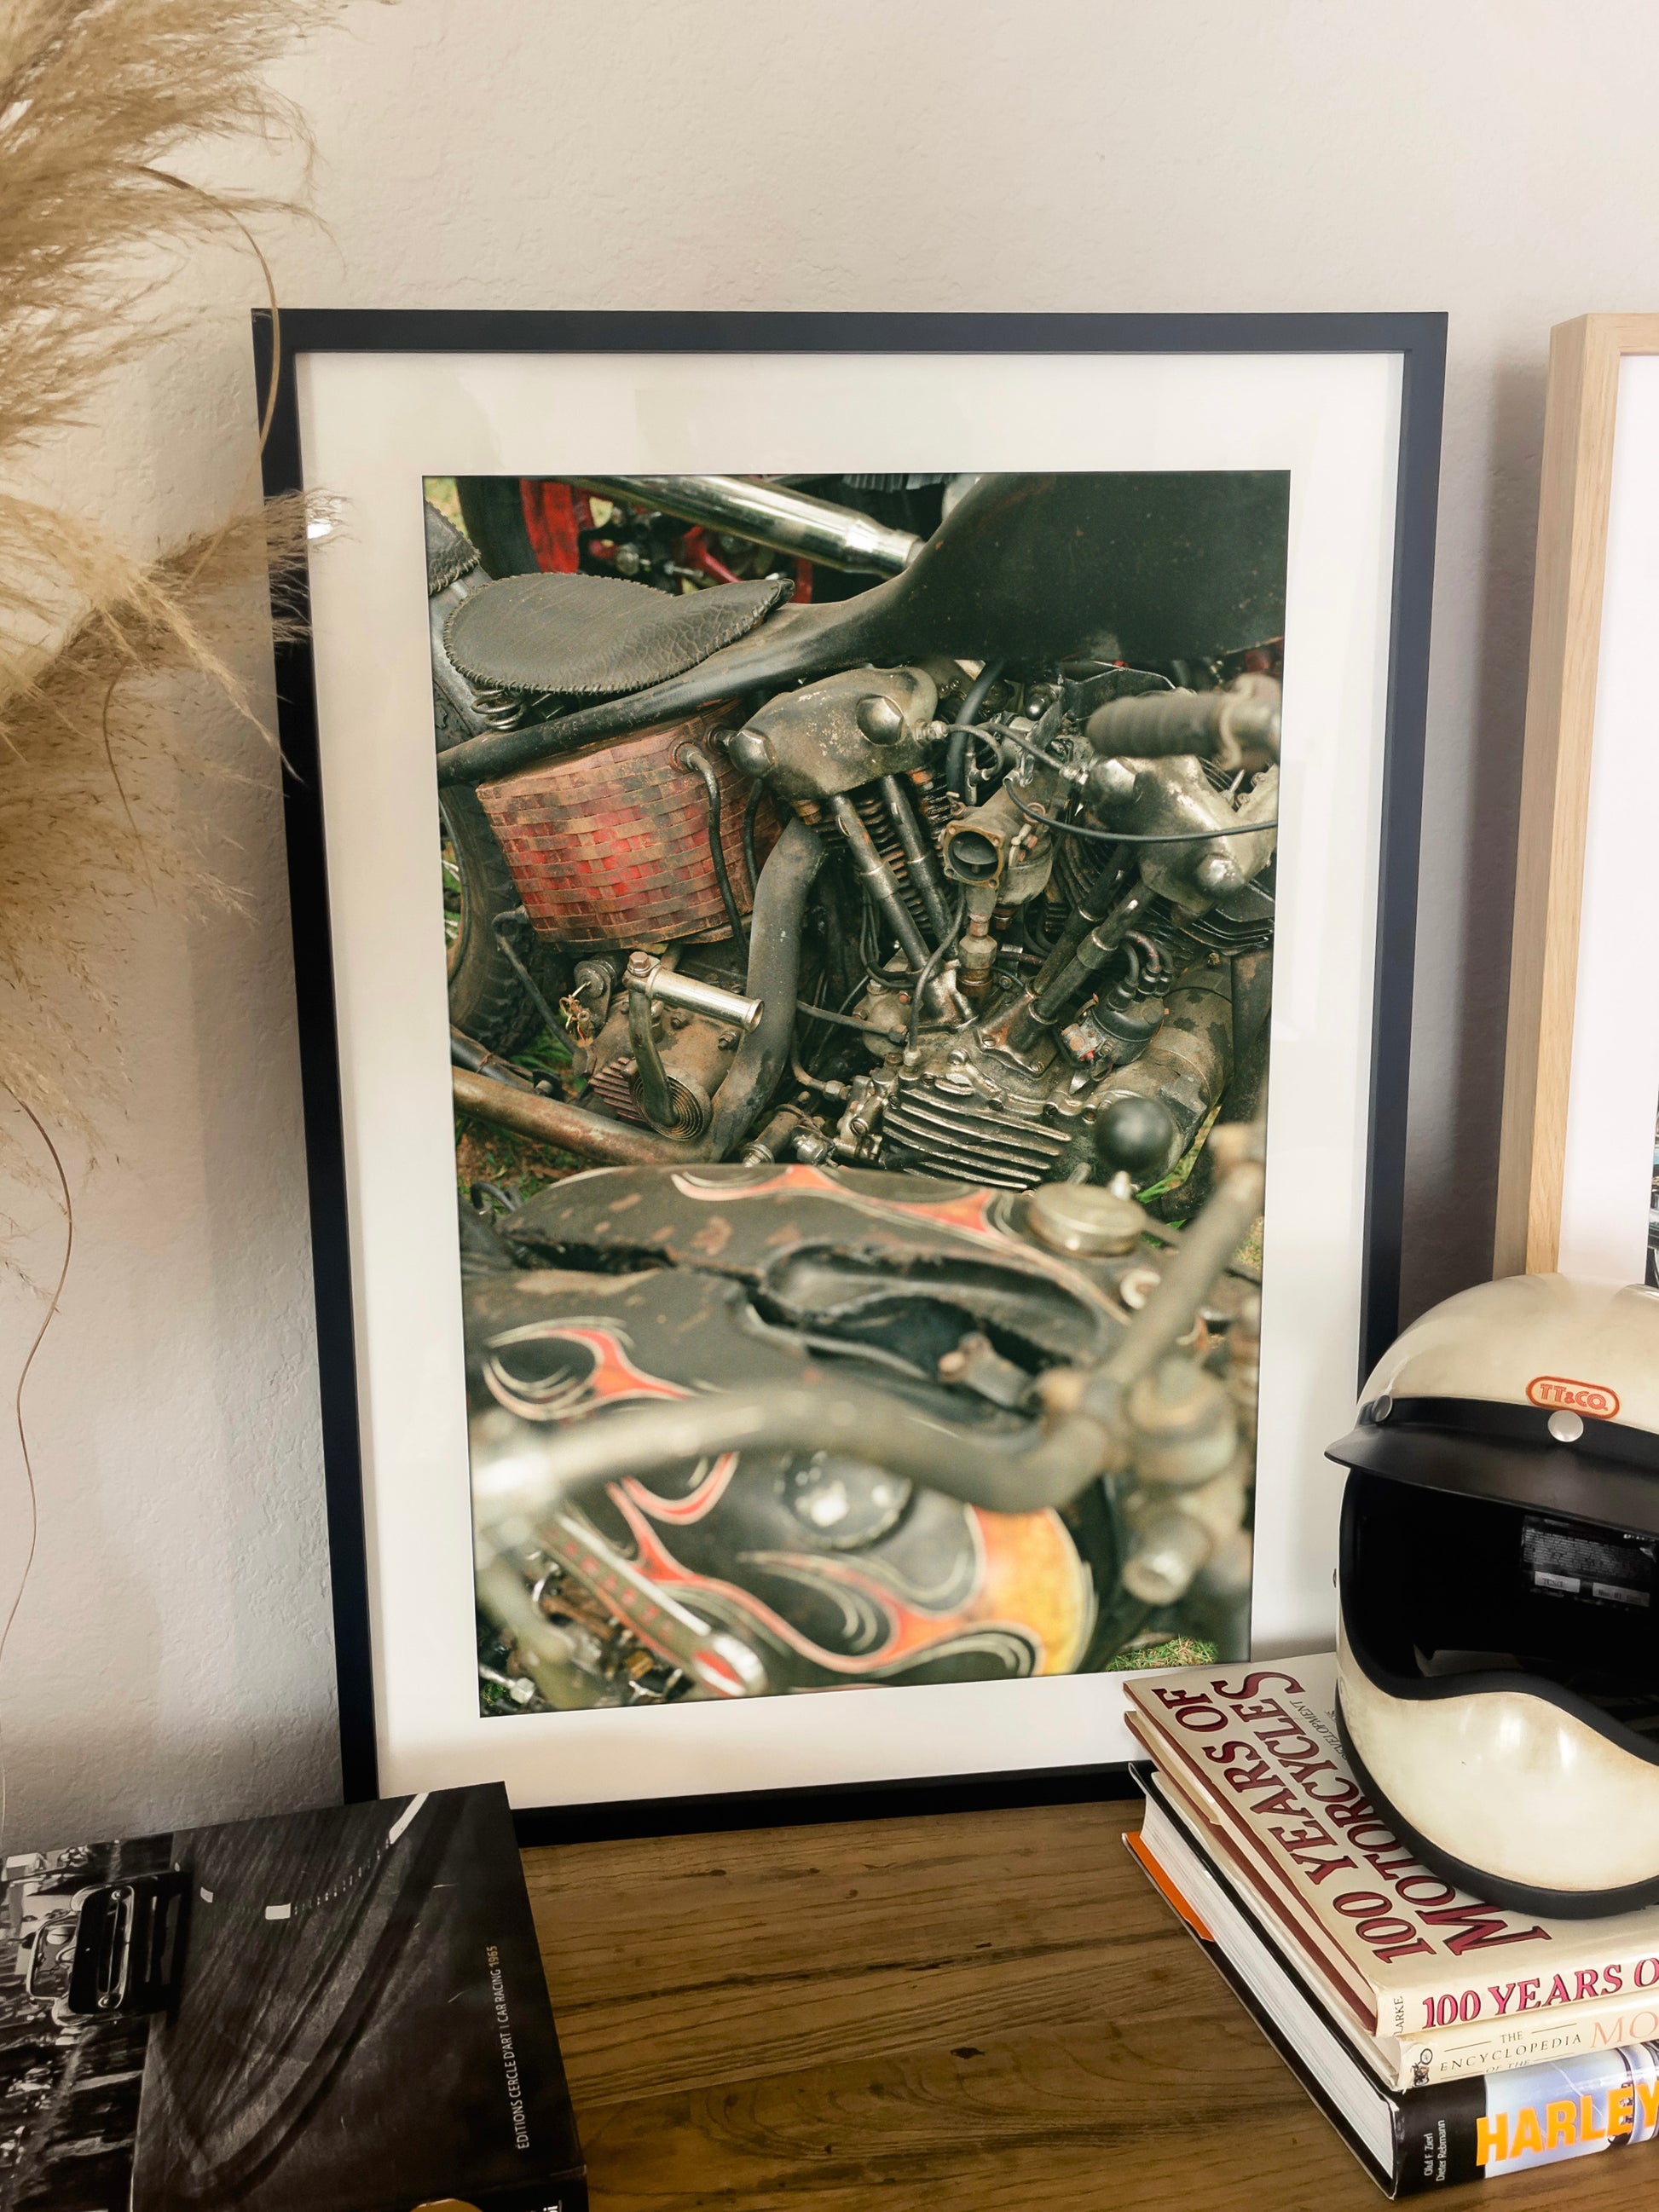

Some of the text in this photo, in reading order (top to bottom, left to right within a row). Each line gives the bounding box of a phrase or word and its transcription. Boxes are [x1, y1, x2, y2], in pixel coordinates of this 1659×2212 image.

[1152, 1688, 1437, 1964] 100 YEARS OF
[1210, 1672, 1552, 1955] MOTORCYCLES
[486, 1945, 500, 1967] 1965
[490, 1969, 506, 2002] RACING
[1422, 1990, 1482, 2030] 100
[1488, 1964, 1623, 2016] YEARS
[496, 2003, 509, 2023] CAR
[500, 2032, 515, 2059] D'ART
[1440, 2034, 1582, 2072] ENCYCLOPEDIA
[1500, 2031, 1523, 2044] THE
[505, 2060, 521, 2098] CERCLE
[1508, 2059, 1532, 2069] THE
[1437, 2119, 1448, 2158] Rebmann
